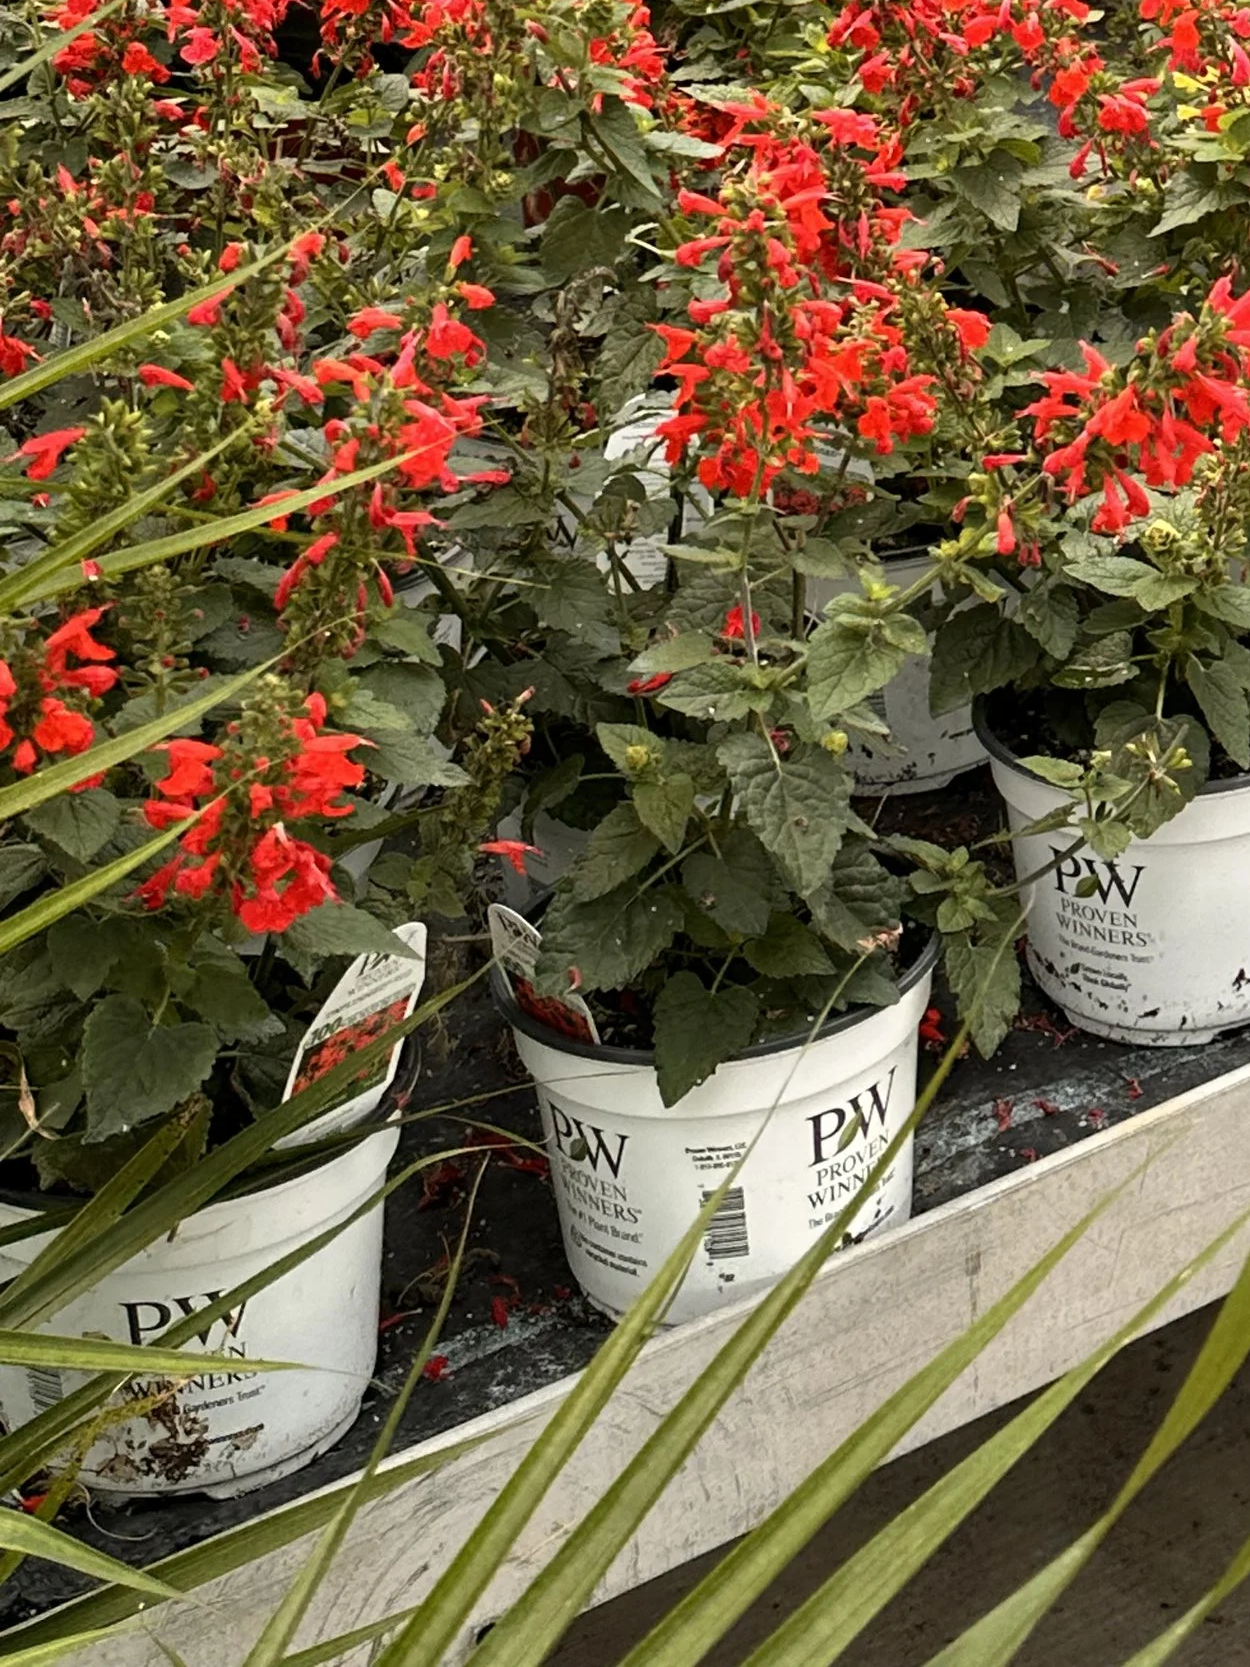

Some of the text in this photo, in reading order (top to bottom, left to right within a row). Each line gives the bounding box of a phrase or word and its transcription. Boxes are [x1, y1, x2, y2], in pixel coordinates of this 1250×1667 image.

[1048, 845, 1147, 908] PW
[1060, 897, 1138, 928] PROVEN
[547, 1100, 629, 1179] PW
[805, 1065, 898, 1167] PW
[560, 1157, 628, 1202] PROVEN
[817, 1130, 890, 1186] PROVEN
[118, 1288, 248, 1346] PW
